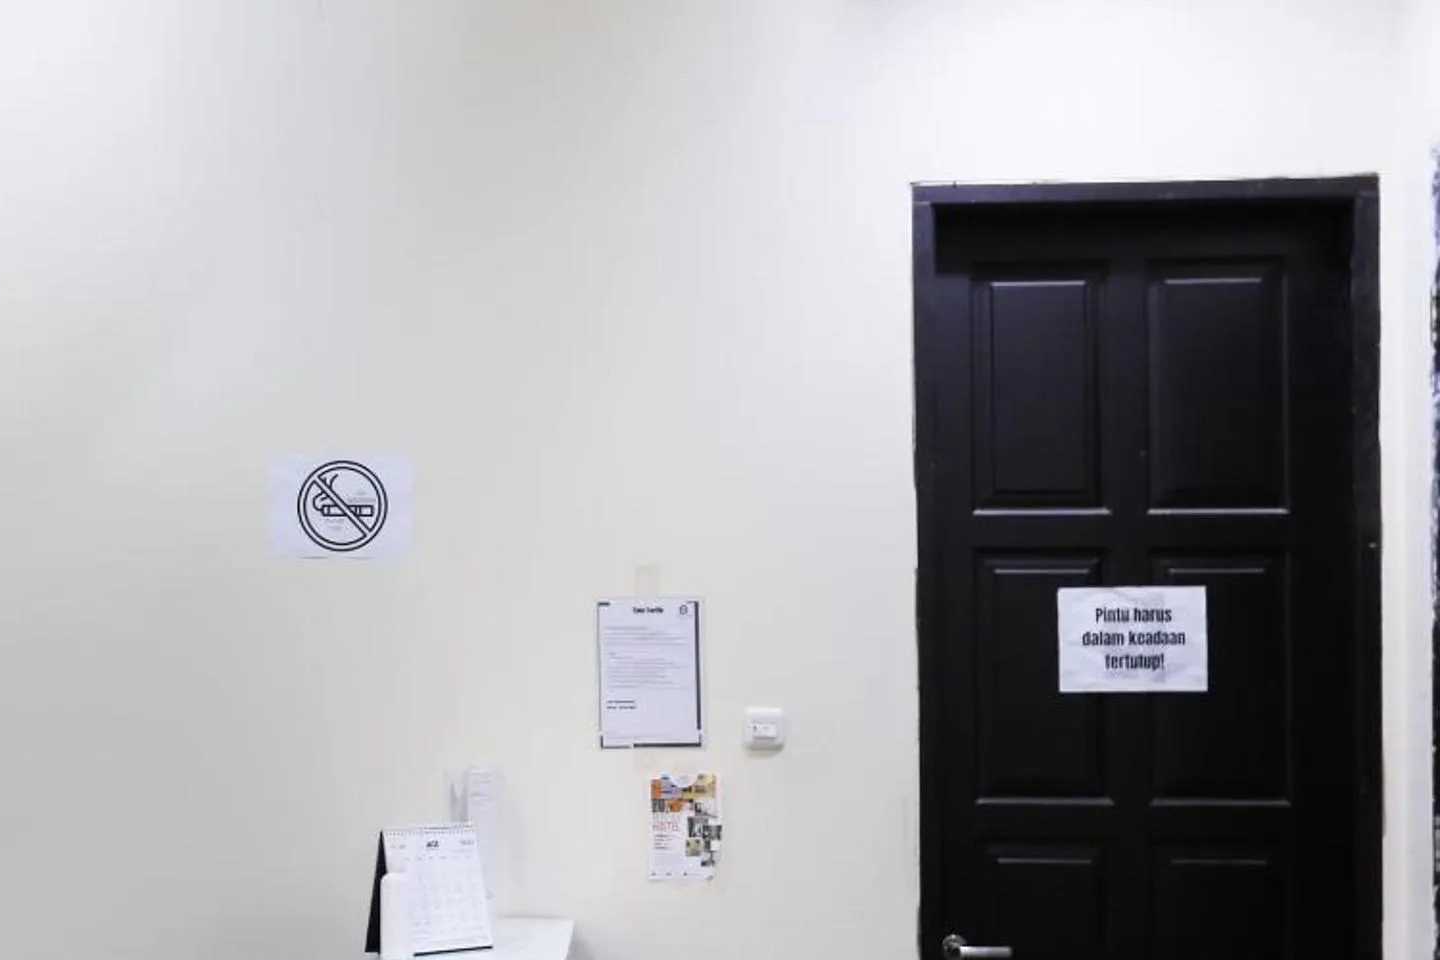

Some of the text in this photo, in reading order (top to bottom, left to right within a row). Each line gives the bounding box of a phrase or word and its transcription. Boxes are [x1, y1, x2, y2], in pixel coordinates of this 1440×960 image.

[1095, 607, 1172, 623] Pintu harus
[1082, 631, 1186, 646] dalam keadaan
[1105, 653, 1165, 671] tertutup!
